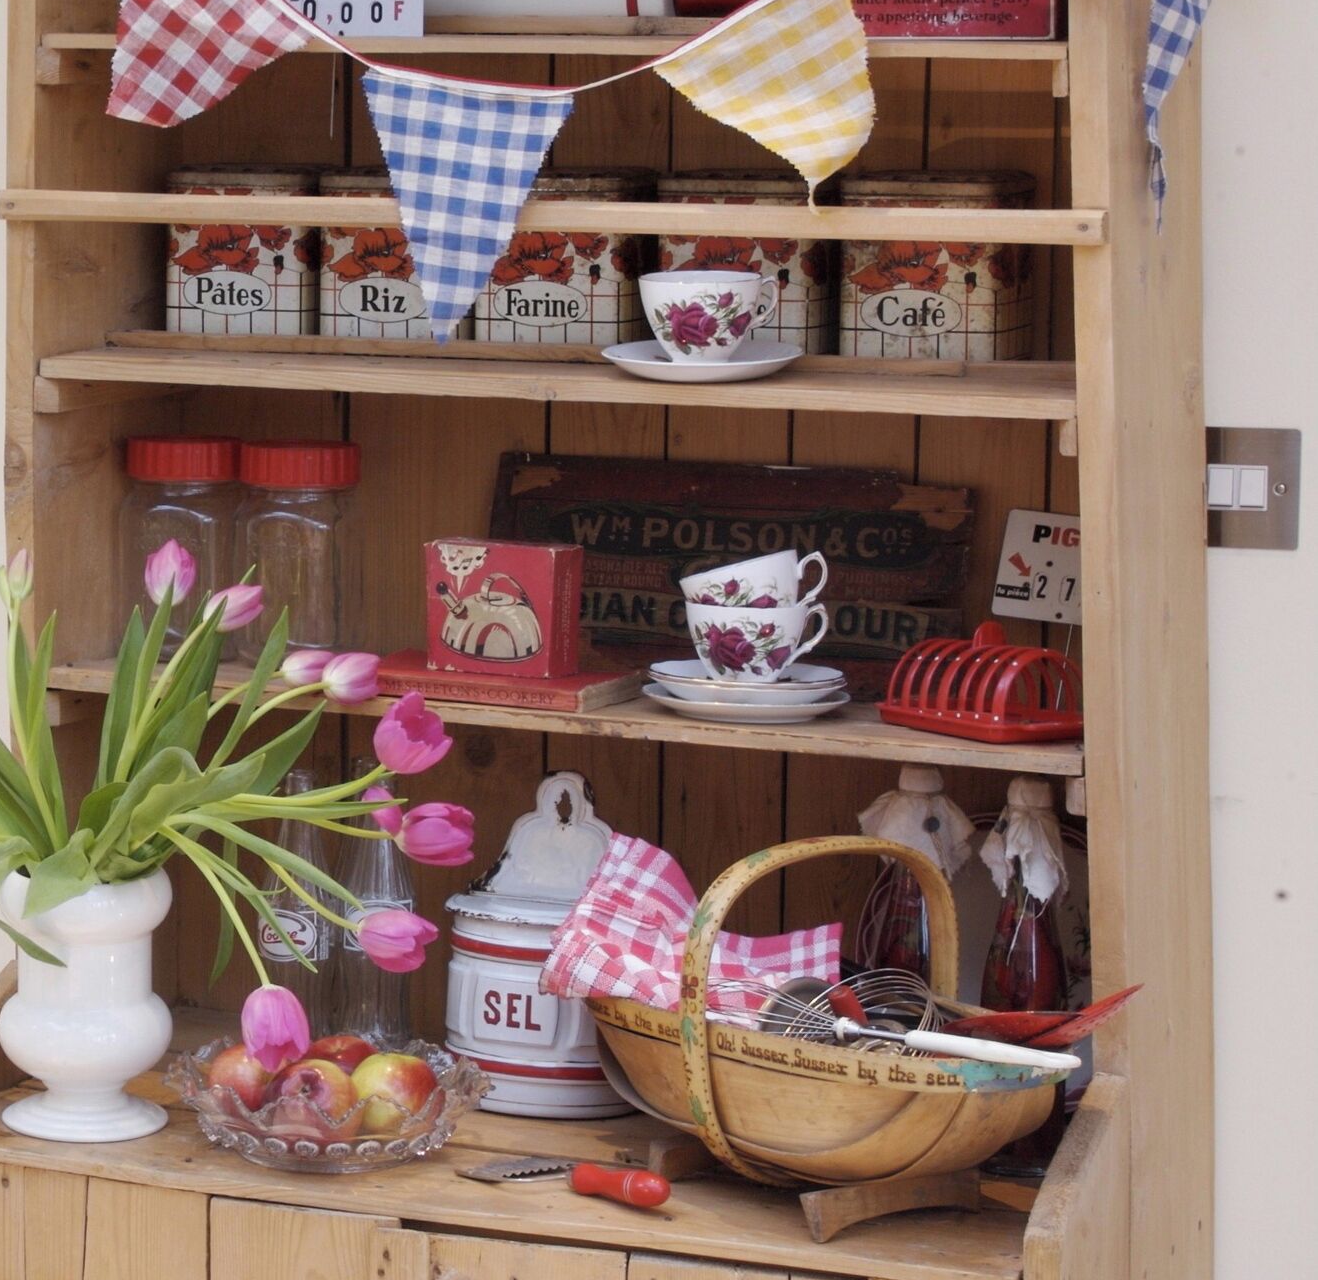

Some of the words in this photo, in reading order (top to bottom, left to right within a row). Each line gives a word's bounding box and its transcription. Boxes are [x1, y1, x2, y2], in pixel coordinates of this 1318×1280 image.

[196, 277, 263, 308] Pâtes
[360, 285, 407, 313] Riz
[505, 289, 579, 320] Farine
[876, 295, 946, 327] Café
[642, 517, 817, 552] POLSON
[483, 990, 541, 1031] SEL
[614, 1008, 629, 1028] by
[634, 1012, 653, 1031] the
[716, 1032, 736, 1052] Oh!
[794, 1048, 848, 1077] Sussex
[858, 1061, 878, 1086] by
[888, 1063, 917, 1083] the
